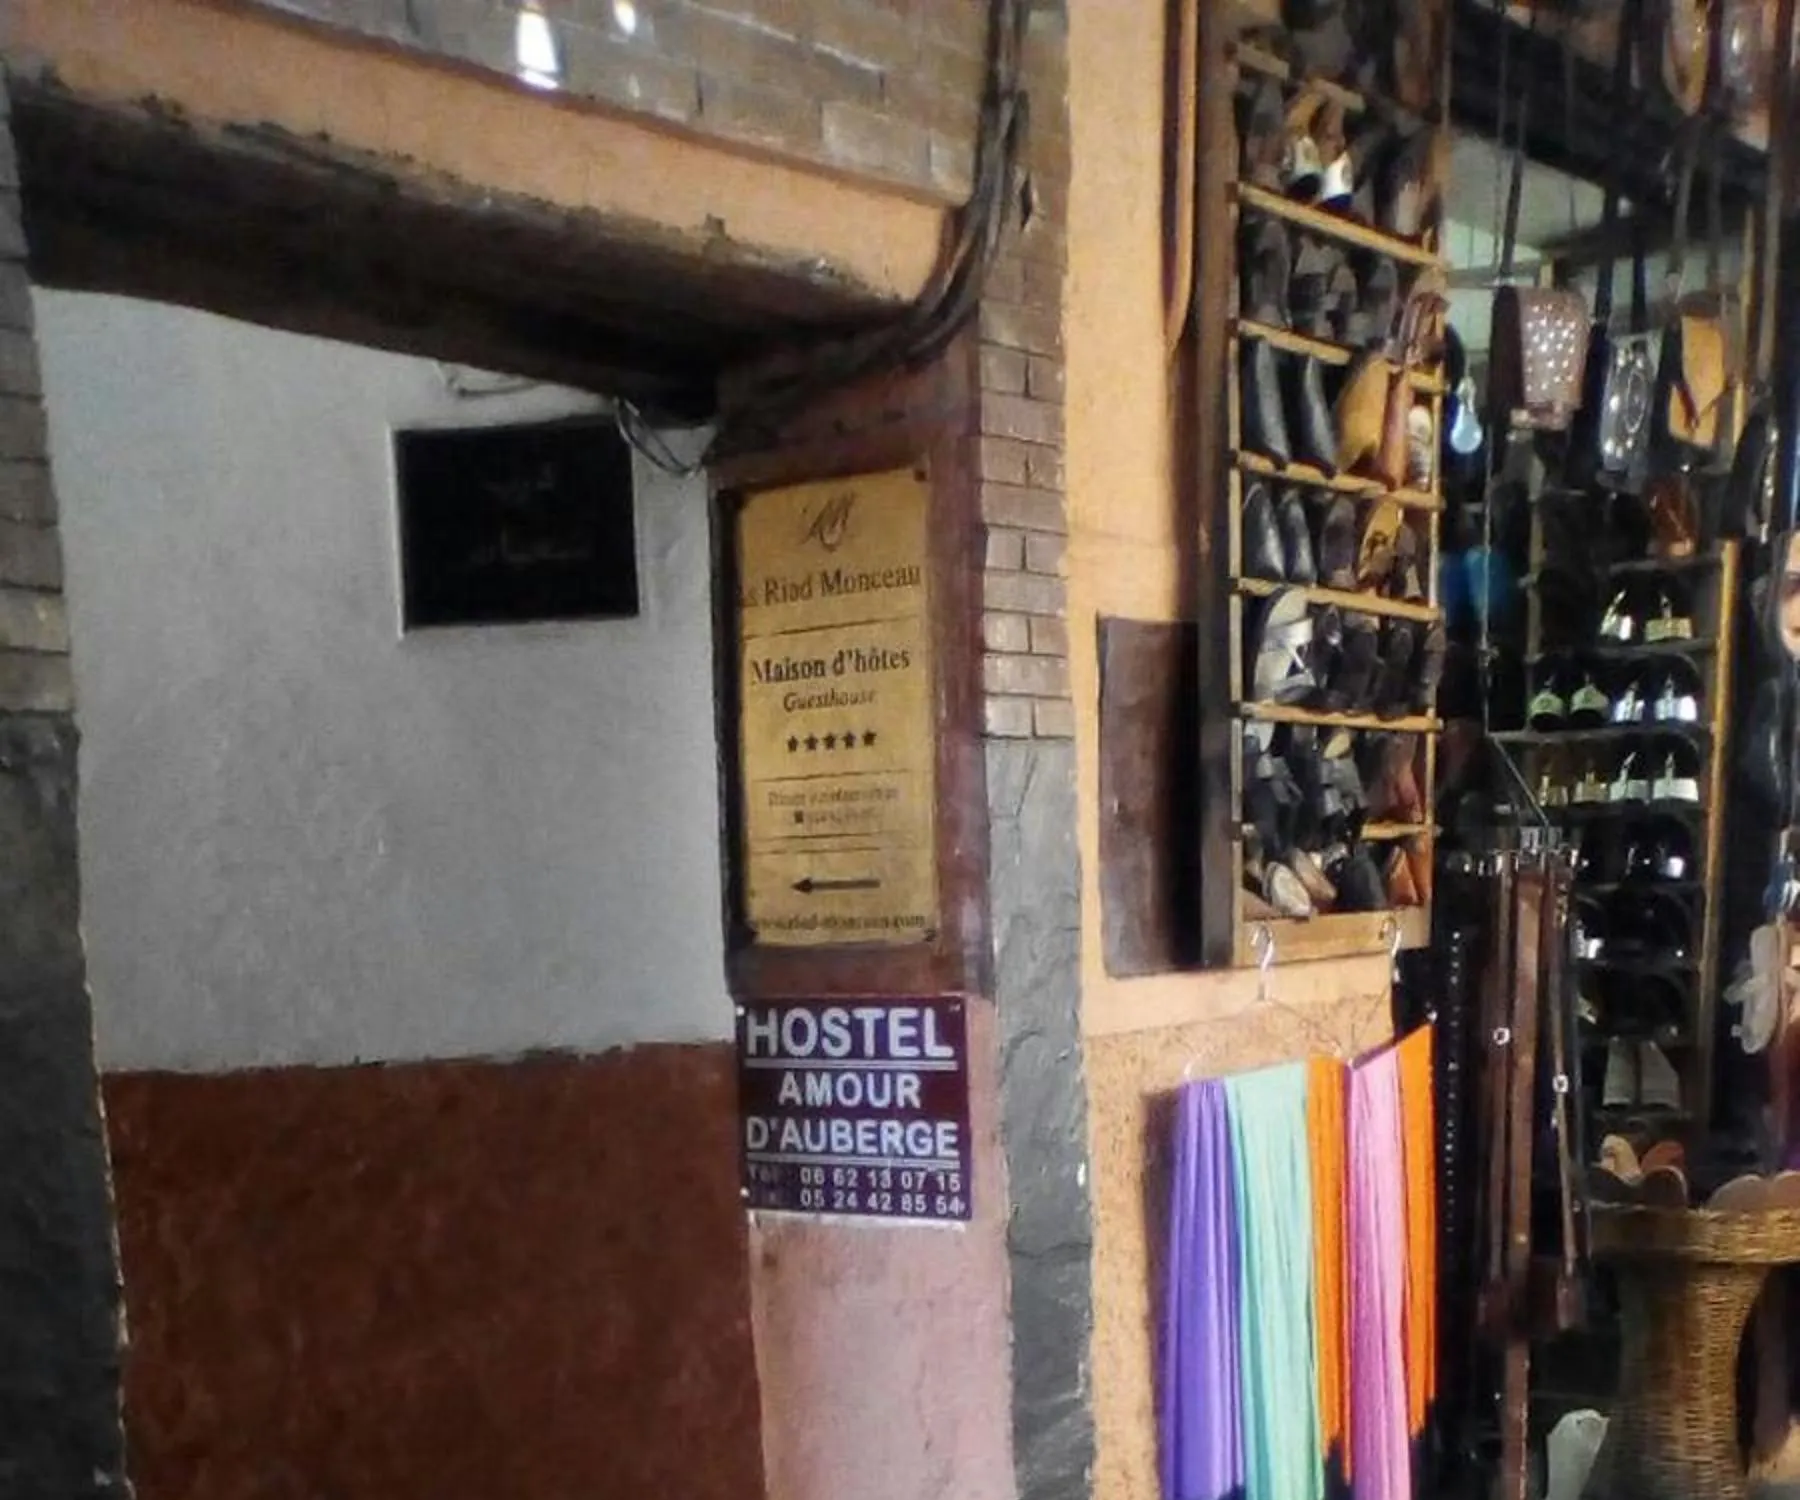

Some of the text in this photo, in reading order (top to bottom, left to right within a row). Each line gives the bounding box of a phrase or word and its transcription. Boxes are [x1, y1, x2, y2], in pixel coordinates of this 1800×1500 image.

[820, 564, 921, 597] Monceau
[752, 649, 911, 684] Maison d'hôtes
[783, 688, 877, 713] Guesthouse
[747, 1007, 954, 1057] HOSTEL
[778, 1071, 921, 1109] AMOUR
[746, 1116, 960, 1157] D'AUBERGE
[801, 1167, 824, 1185] 06
[902, 1171, 927, 1191] 07
[801, 1189, 824, 1207] 05
[833, 1190, 858, 1209] 24
[868, 1192, 892, 1211] 42
